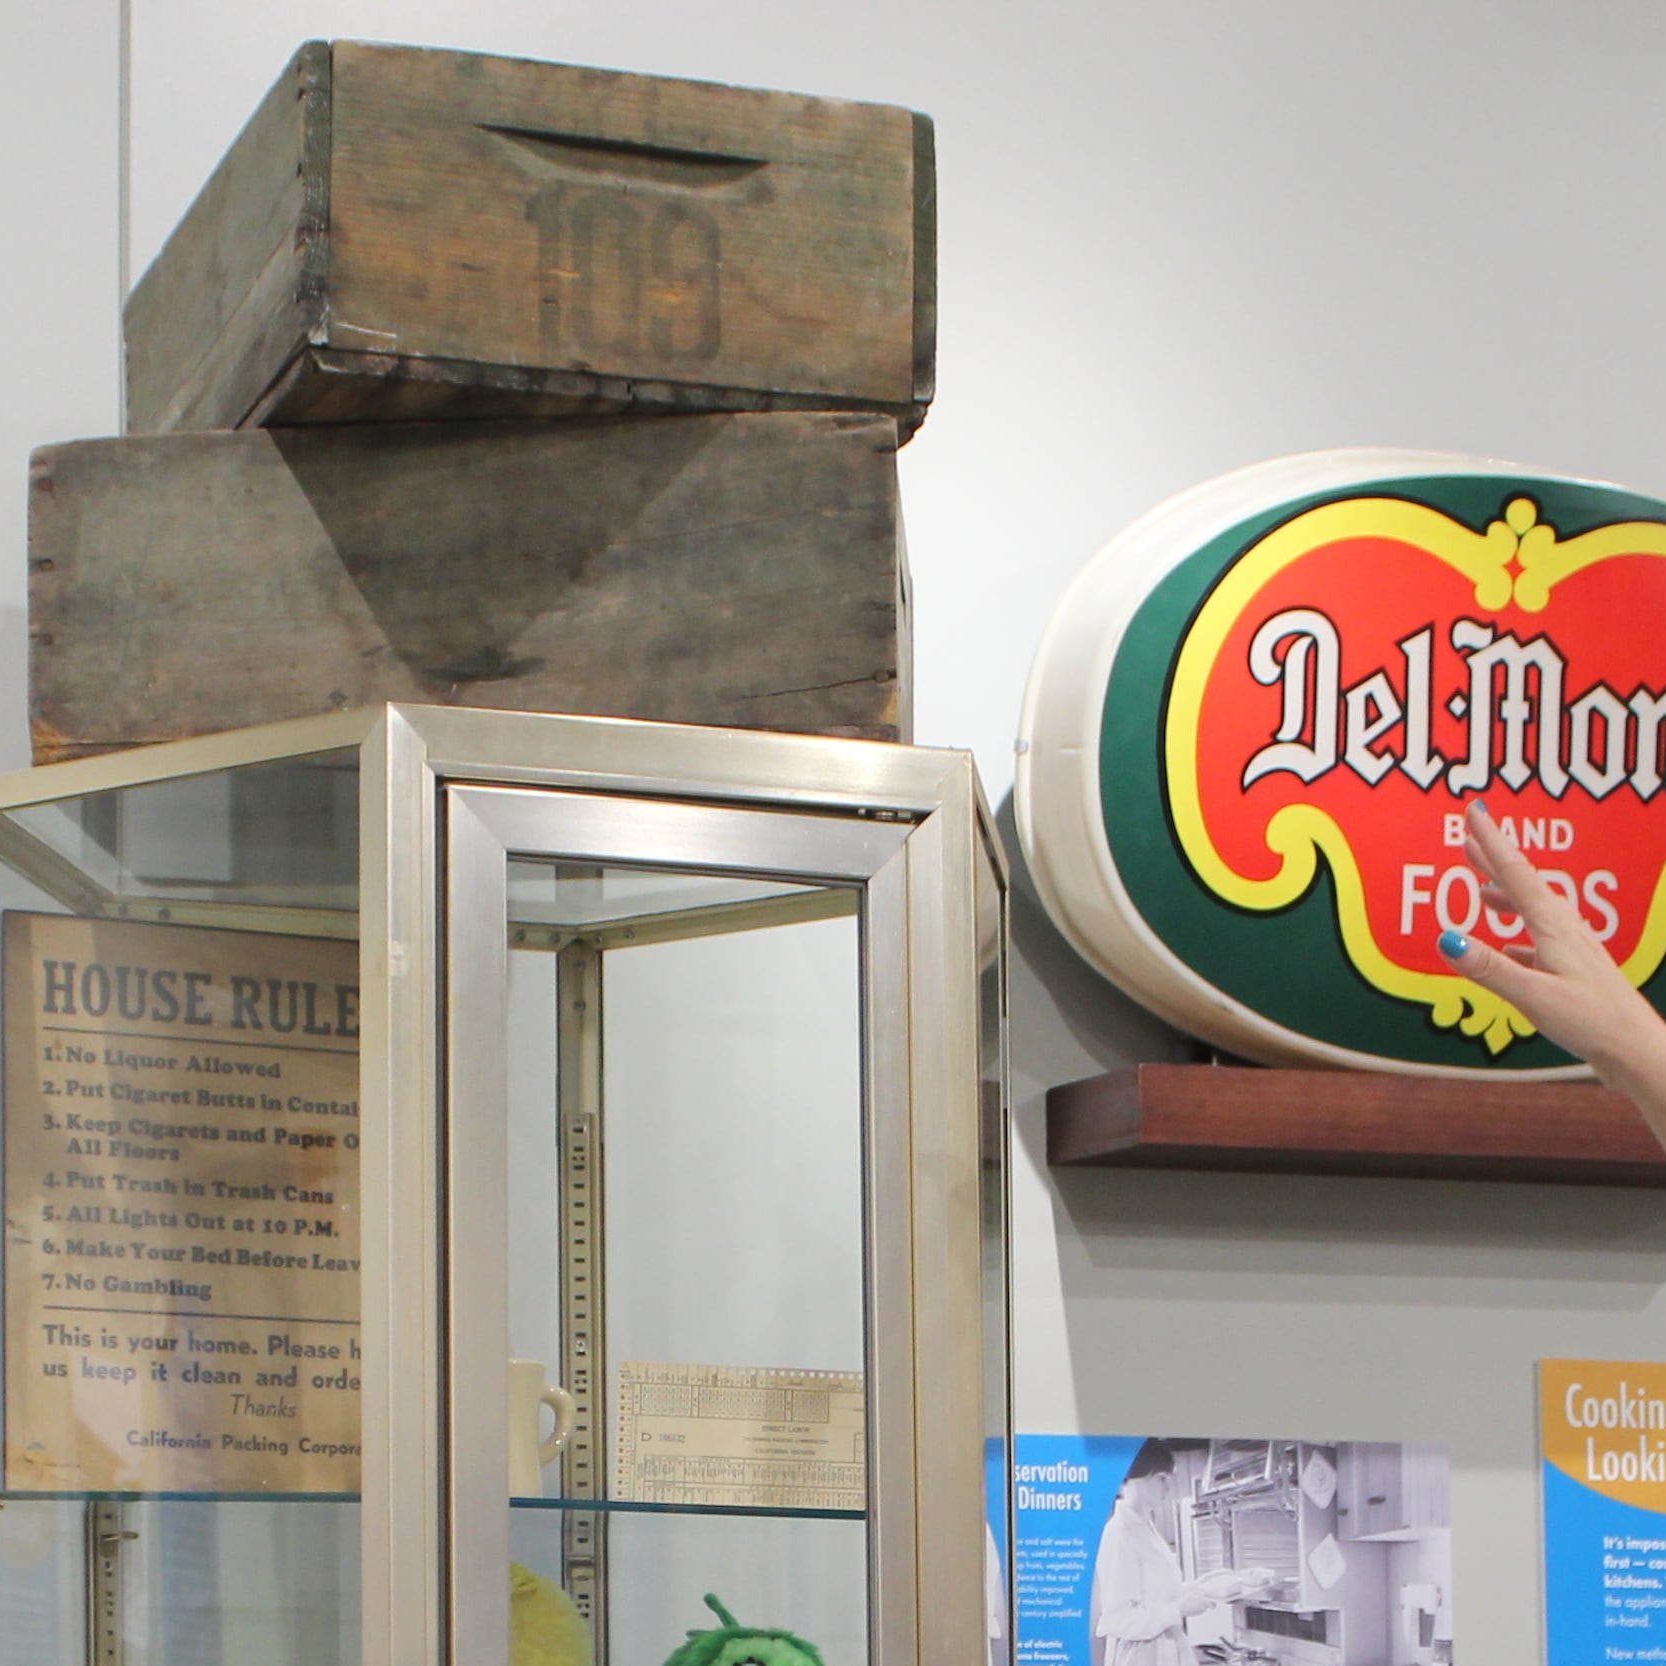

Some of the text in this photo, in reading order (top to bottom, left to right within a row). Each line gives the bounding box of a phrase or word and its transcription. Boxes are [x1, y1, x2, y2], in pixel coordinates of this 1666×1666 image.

[1444, 813, 1574, 851] BAND
[43, 960, 359, 1038] HOUSE RULE
[43, 1046, 280, 1078] 1. No Liquor Allowed
[43, 1081, 61, 1095] 2.
[65, 1080, 103, 1098] Put
[110, 1083, 190, 1106] Cigaret
[197, 1090, 255, 1109] Butts
[261, 1093, 281, 1111] in
[43, 1116, 61, 1131] 3.
[65, 1114, 120, 1137] Keep
[128, 1119, 219, 1142] Cigarets
[227, 1125, 265, 1143] and
[274, 1127, 335, 1149] Paper
[67, 1138, 180, 1162] All Floors
[43, 1172, 333, 1204] 4. Put Trash in Trash Cans
[42, 1206, 339, 1237] 5. All Lights Out at 10 P.M.
[42, 1239, 61, 1254] 6.
[66, 1239, 125, 1258] Make
[131, 1242, 185, 1262] Your
[191, 1246, 231, 1264] Bed
[235, 1249, 306, 1269] Before
[42, 1274, 211, 1301] 7. No Gambling
[43, 1325, 90, 1347] This
[102, 1328, 118, 1349] is
[129, 1336, 178, 1353] your
[188, 1331, 257, 1355] home.
[268, 1335, 340, 1359] Please
[43, 1362, 67, 1377] us
[82, 1357, 136, 1385] keep
[151, 1361, 167, 1380] it
[182, 1365, 240, 1385] clean
[256, 1366, 297, 1387] and
[231, 1394, 297, 1418] Thanks
[127, 1431, 211, 1450] California
[222, 1435, 288, 1456] Packing
[1019, 1486, 1081, 1510] Dinners
[1604, 1537, 1623, 1550] It's
[1604, 1556, 1630, 1569] first
[1605, 1575, 1662, 1588] kitchens.
[1605, 1595, 1621, 1608] the
[1605, 1615, 1651, 1627] in-hand.
